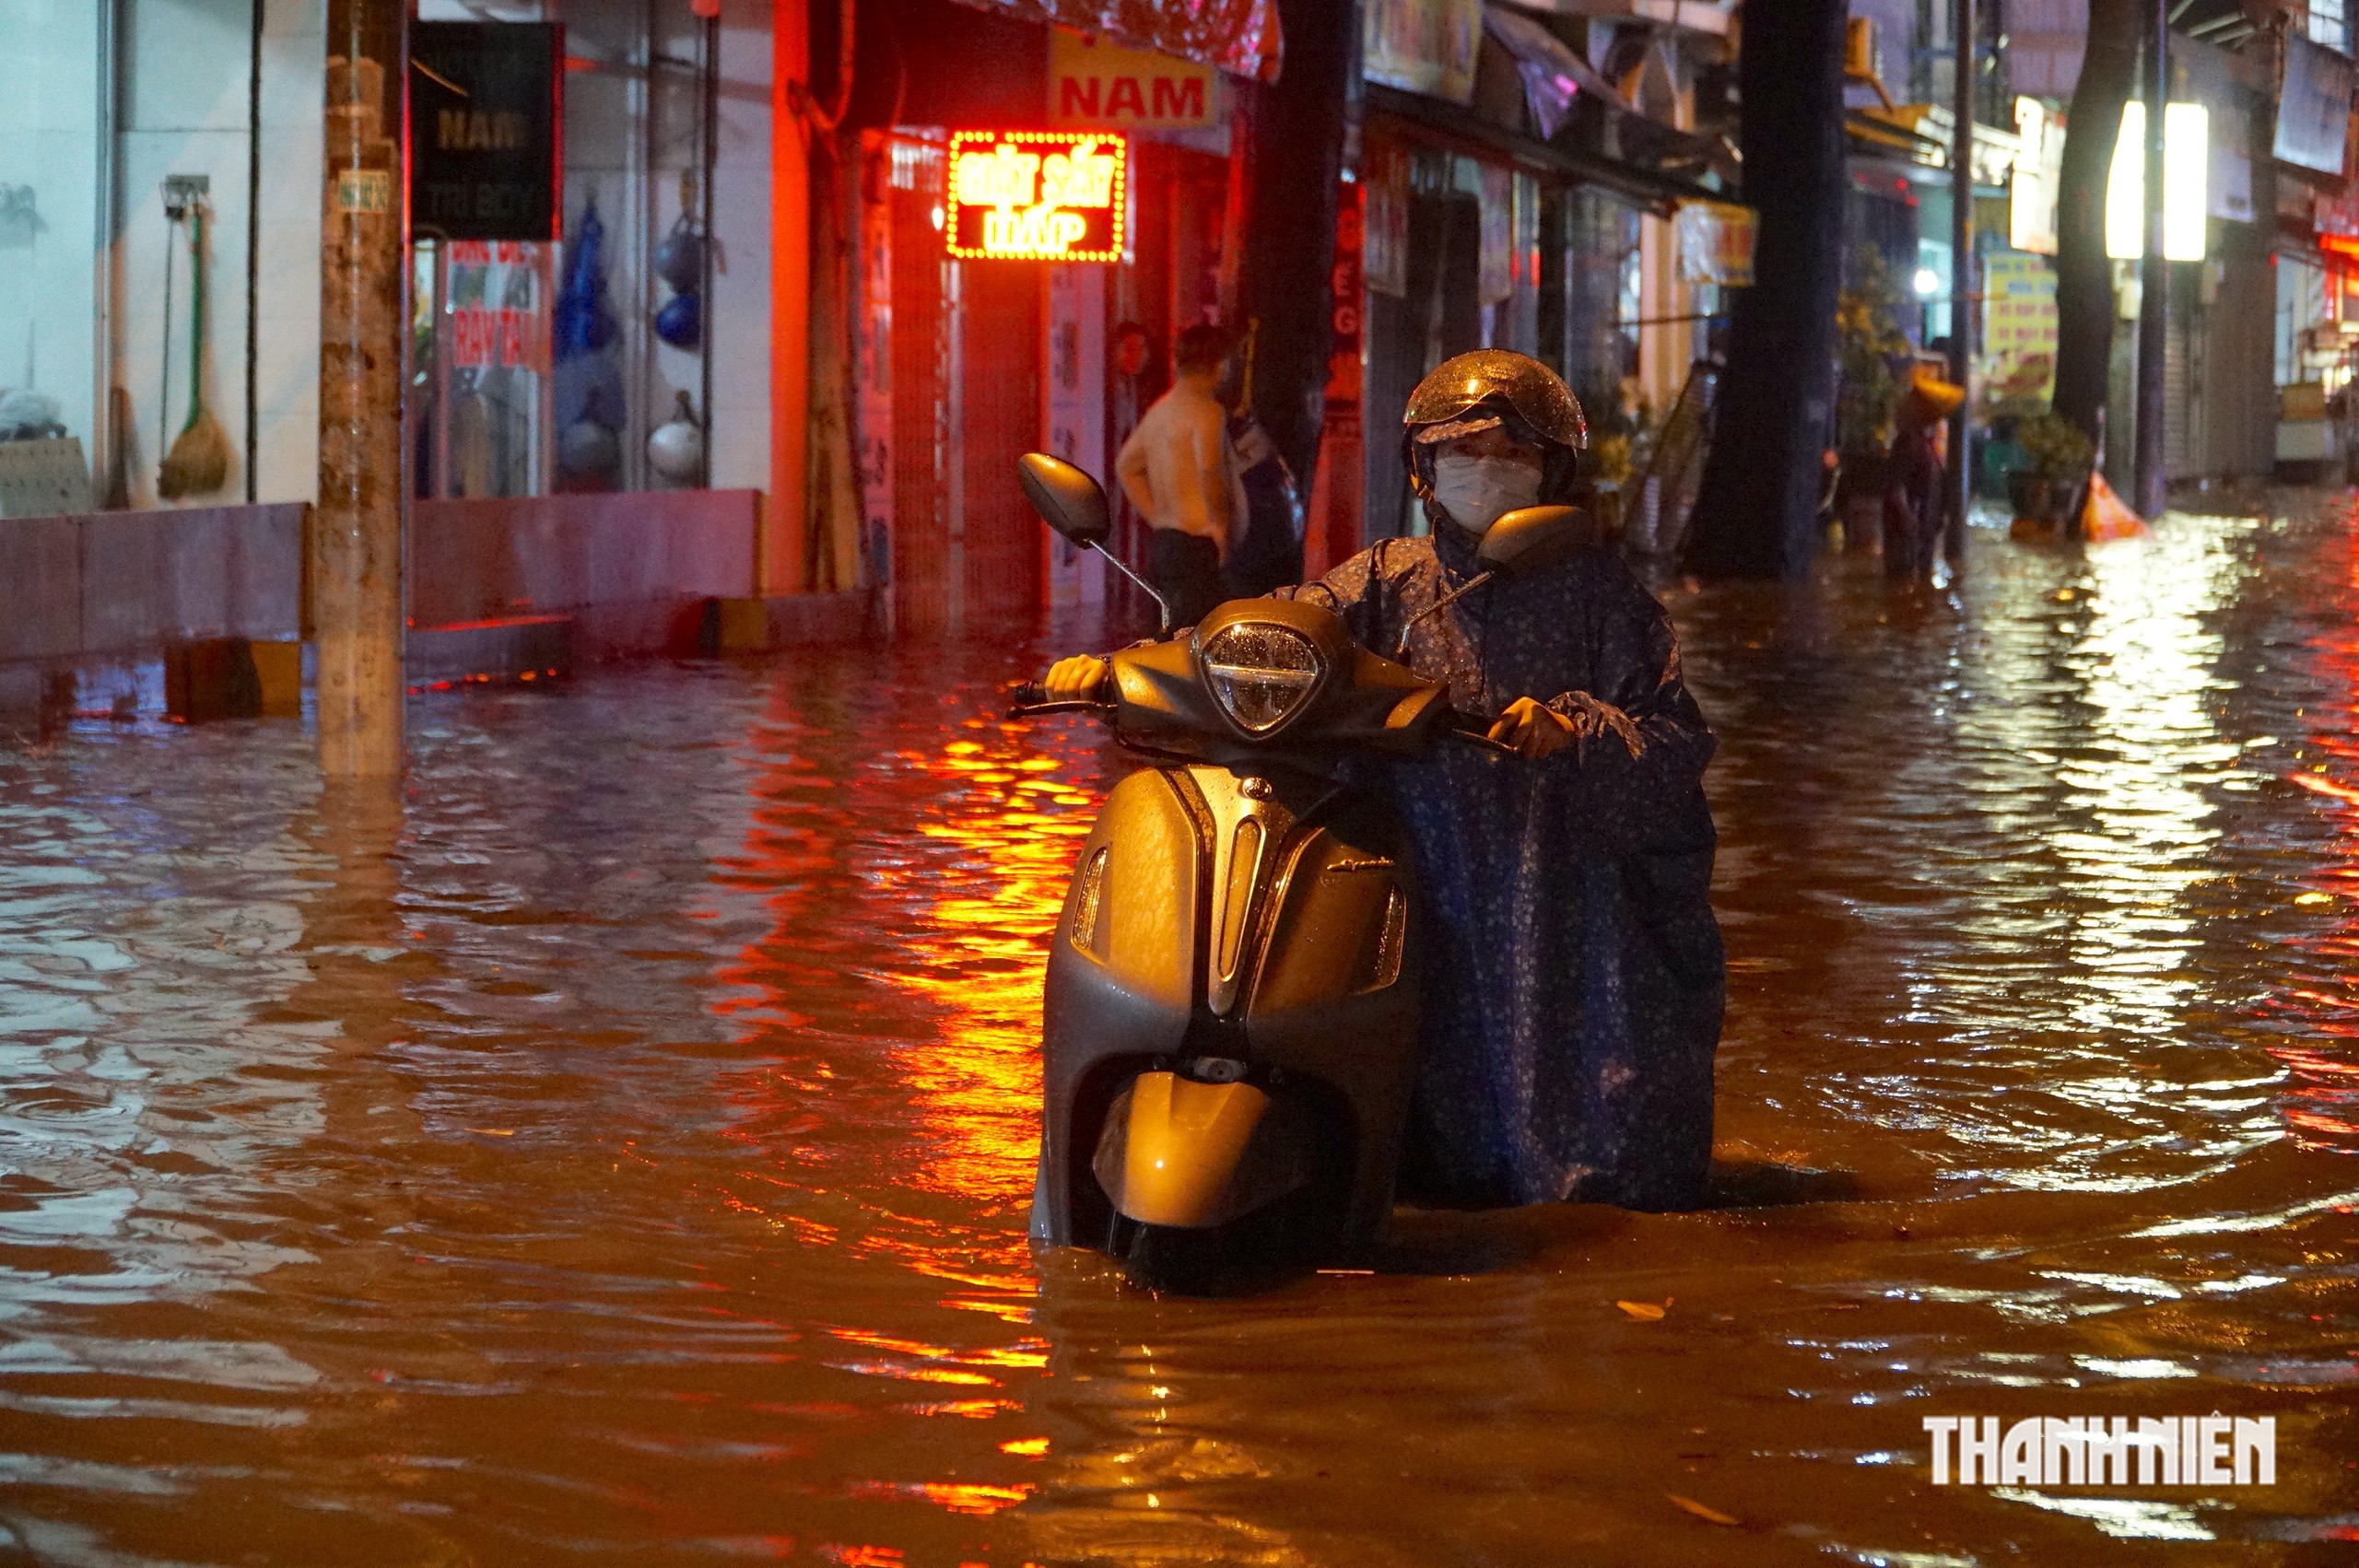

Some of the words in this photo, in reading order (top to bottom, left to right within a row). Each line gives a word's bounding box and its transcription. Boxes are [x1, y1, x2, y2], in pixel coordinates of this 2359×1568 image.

[1062, 76, 1203, 118] NAM
[957, 144, 1039, 214] GIẶT
[1042, 136, 1117, 207] SẤY
